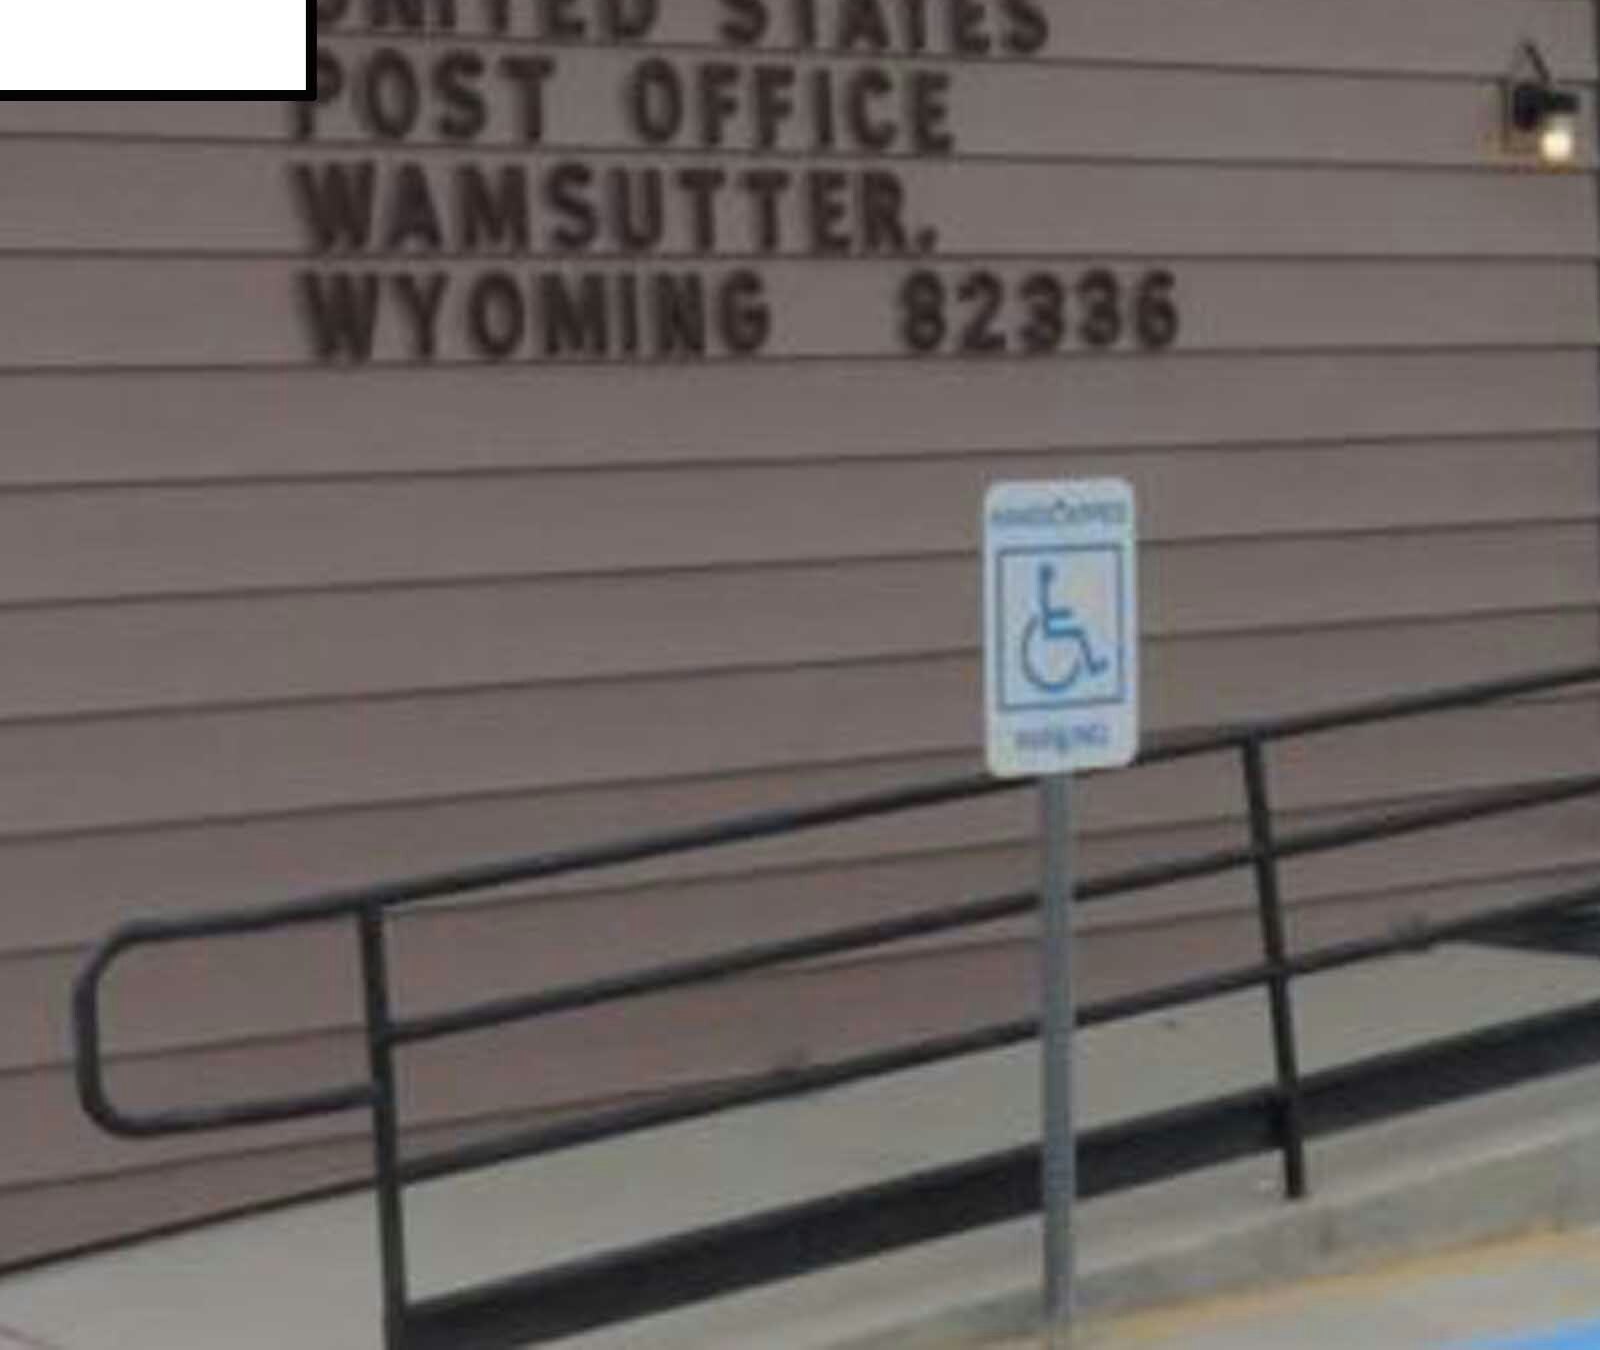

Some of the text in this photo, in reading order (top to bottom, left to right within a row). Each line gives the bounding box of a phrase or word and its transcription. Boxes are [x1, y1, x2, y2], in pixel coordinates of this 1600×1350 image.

[295, 50, 953, 152] POST OFFICE
[300, 269, 1180, 357] WYOMING 82336
